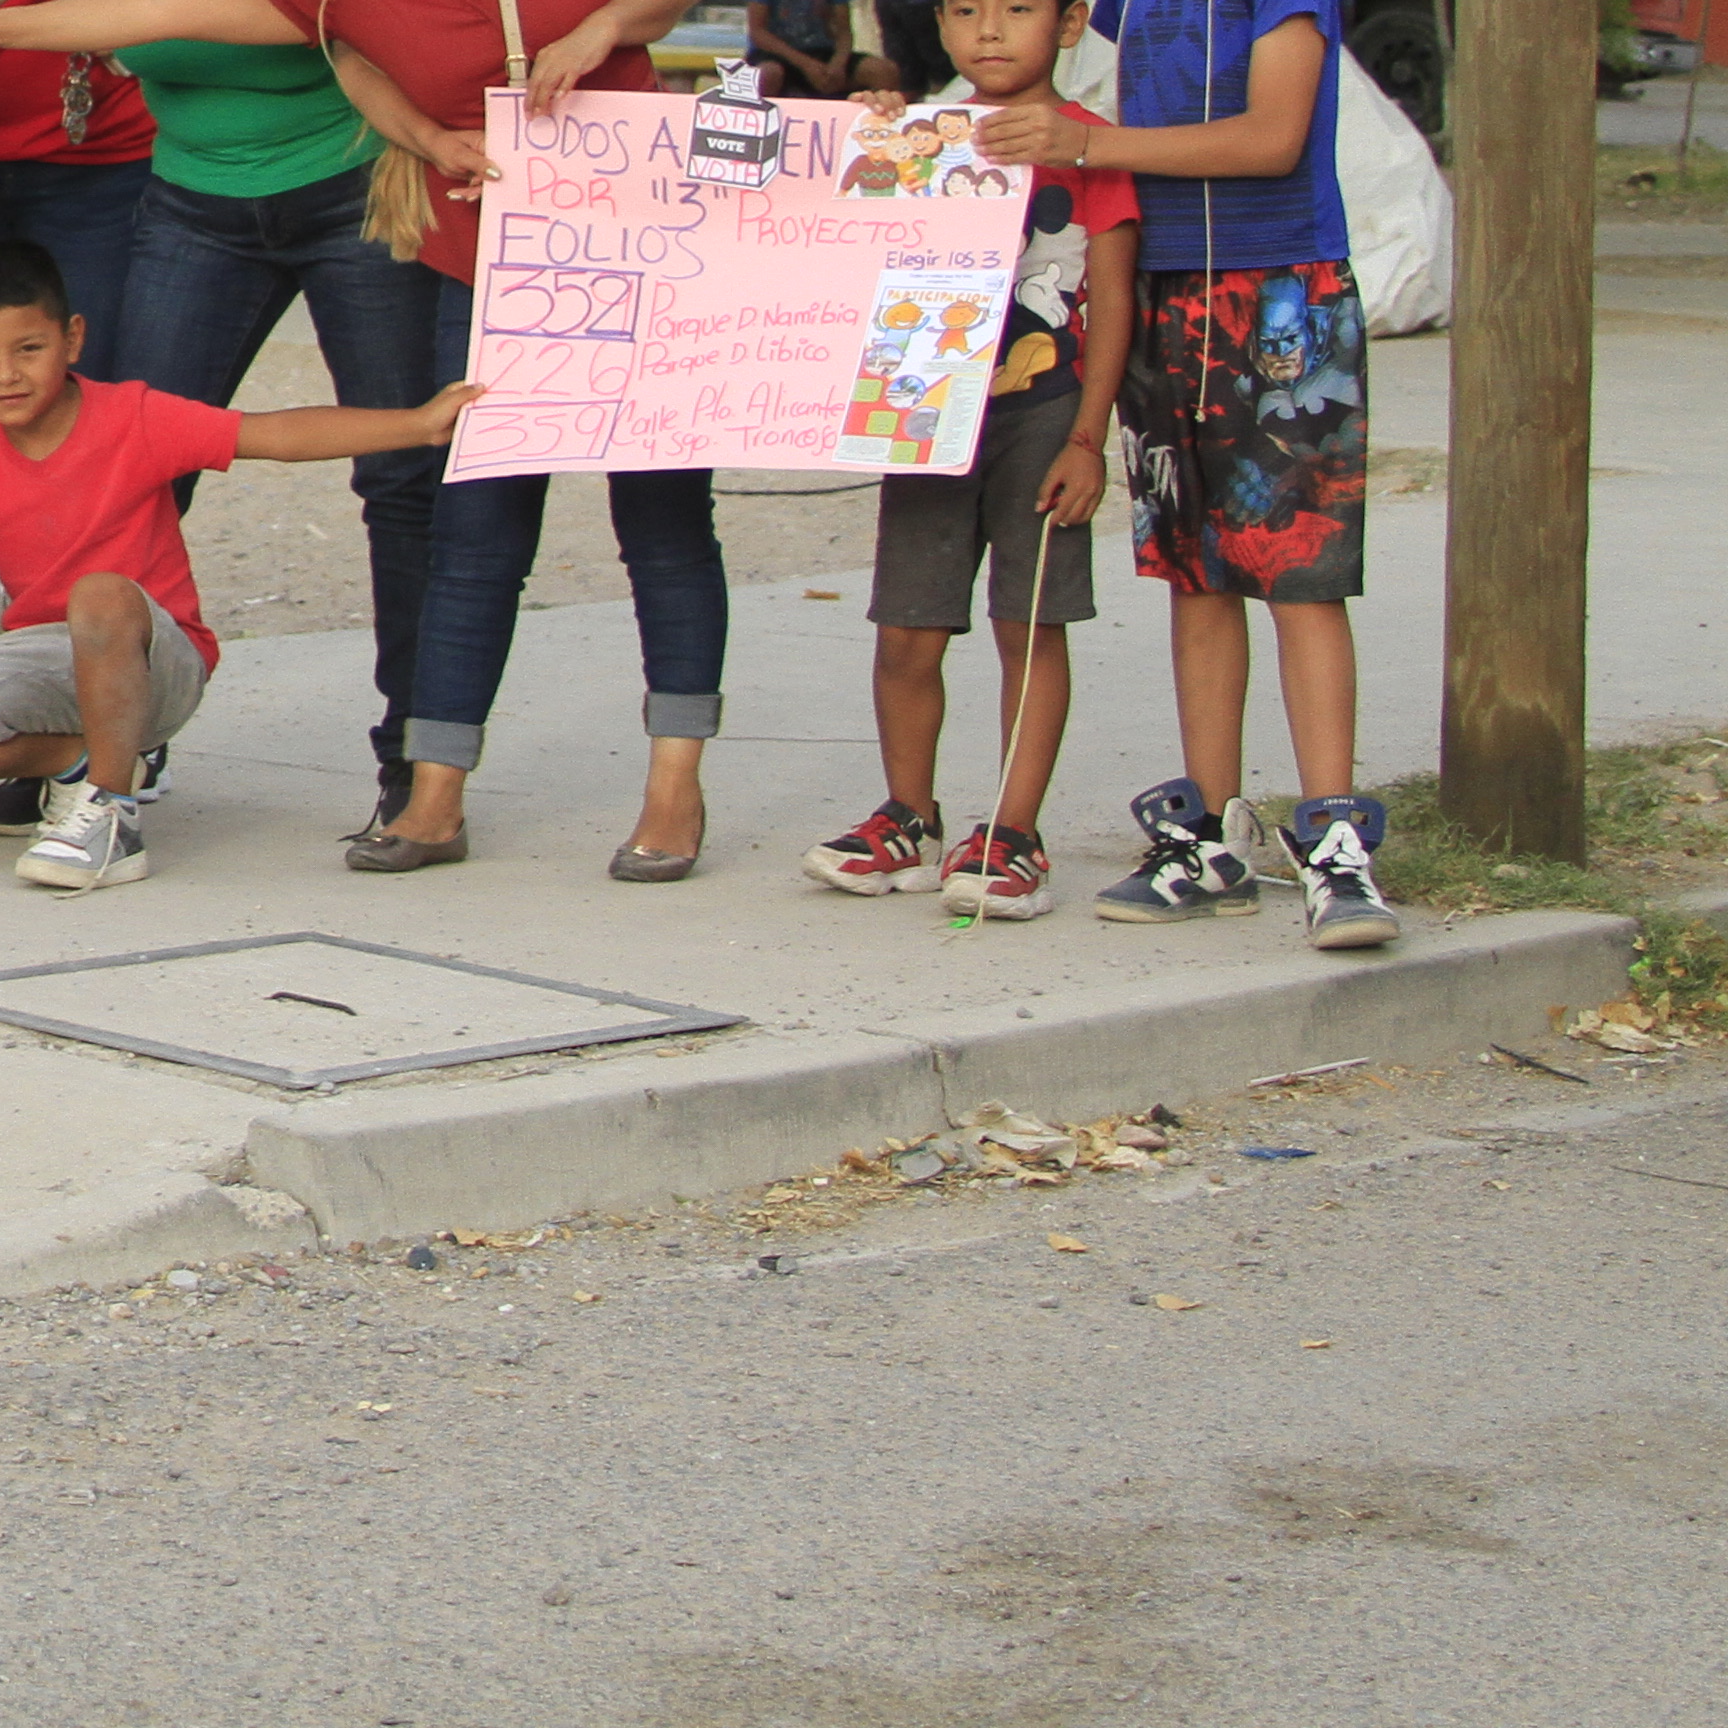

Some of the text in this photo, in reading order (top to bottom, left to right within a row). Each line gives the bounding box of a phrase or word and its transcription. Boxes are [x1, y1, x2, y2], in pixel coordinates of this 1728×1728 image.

[490, 93, 683, 175] TODOS A
[696, 103, 760, 133] VOTA
[707, 138, 746, 153] VOTE
[691, 156, 761, 182] VOTA
[779, 116, 836, 179] EN
[527, 156, 617, 217] POR
[737, 191, 928, 248] PROYECTOS
[500, 212, 704, 279] FOLIOS
[886, 249, 941, 270] Elegir
[948, 251, 975, 268] los
[648, 281, 731, 343] Parque
[763, 303, 858, 326] Namibia
[485, 339, 631, 396] 226
[640, 342, 720, 380] Parque
[757, 337, 830, 362] Libico
[459, 403, 605, 458] 359
[610, 400, 678, 446] Calle
[747, 382, 845, 425] Alicante
